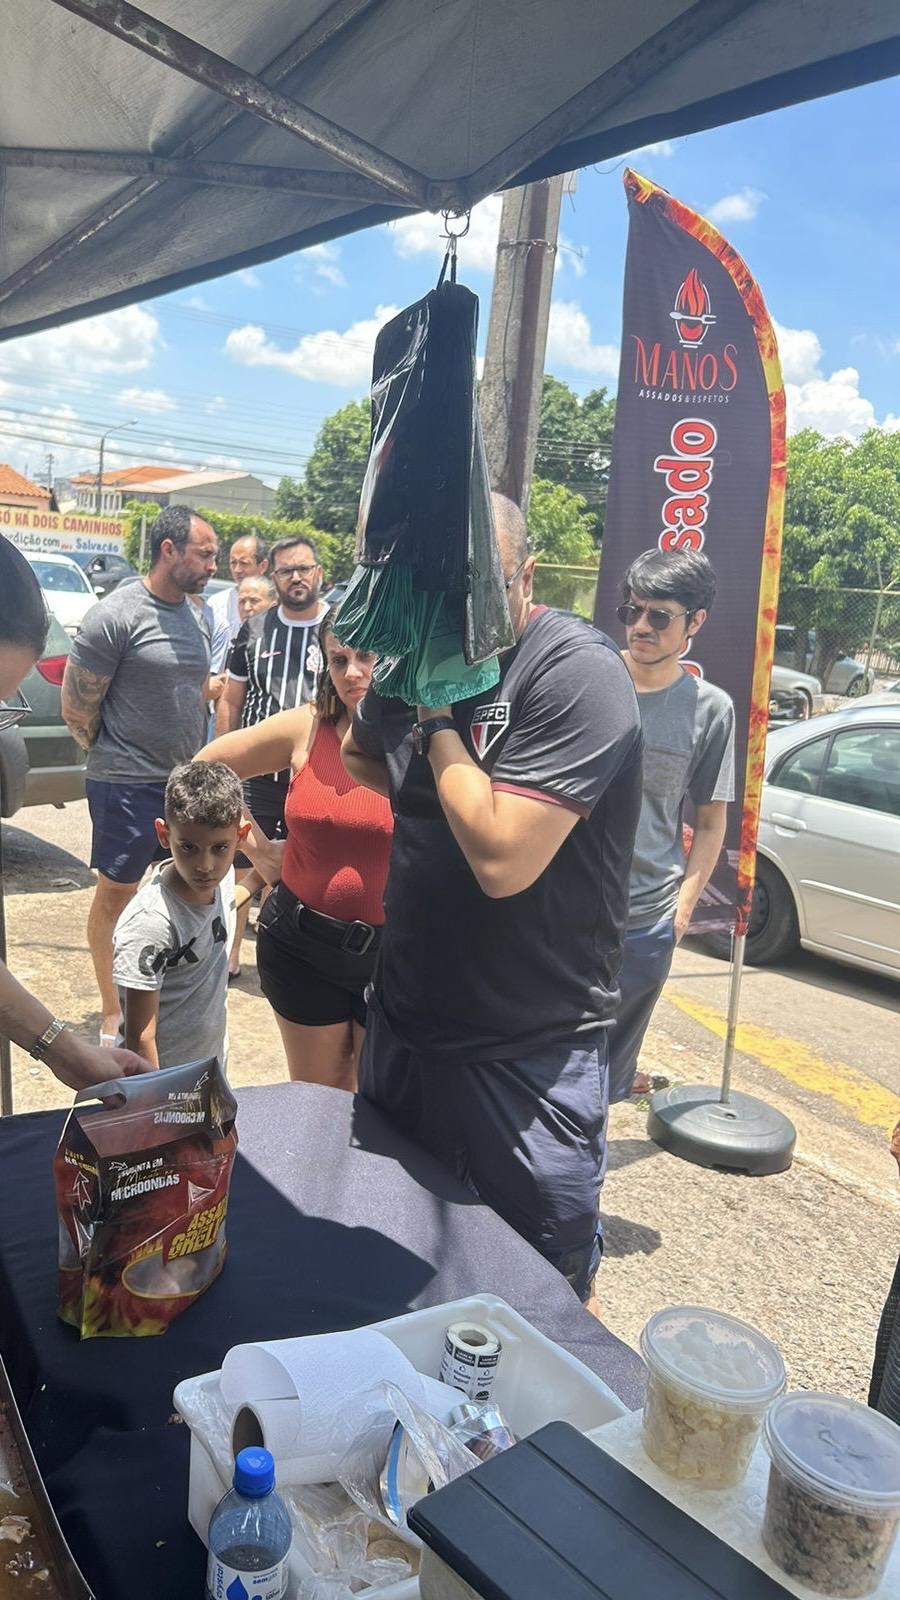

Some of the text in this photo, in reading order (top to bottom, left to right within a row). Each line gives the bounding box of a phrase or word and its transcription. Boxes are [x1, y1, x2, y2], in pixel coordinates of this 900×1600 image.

[631, 335, 738, 391] MANOS
[654, 417, 717, 551] sado
[33, 514, 59, 529] DOIS
[76, 538, 119, 553] Salvação
[475, 707, 505, 721] SPFC
[216, 1563, 225, 1599] crystal
